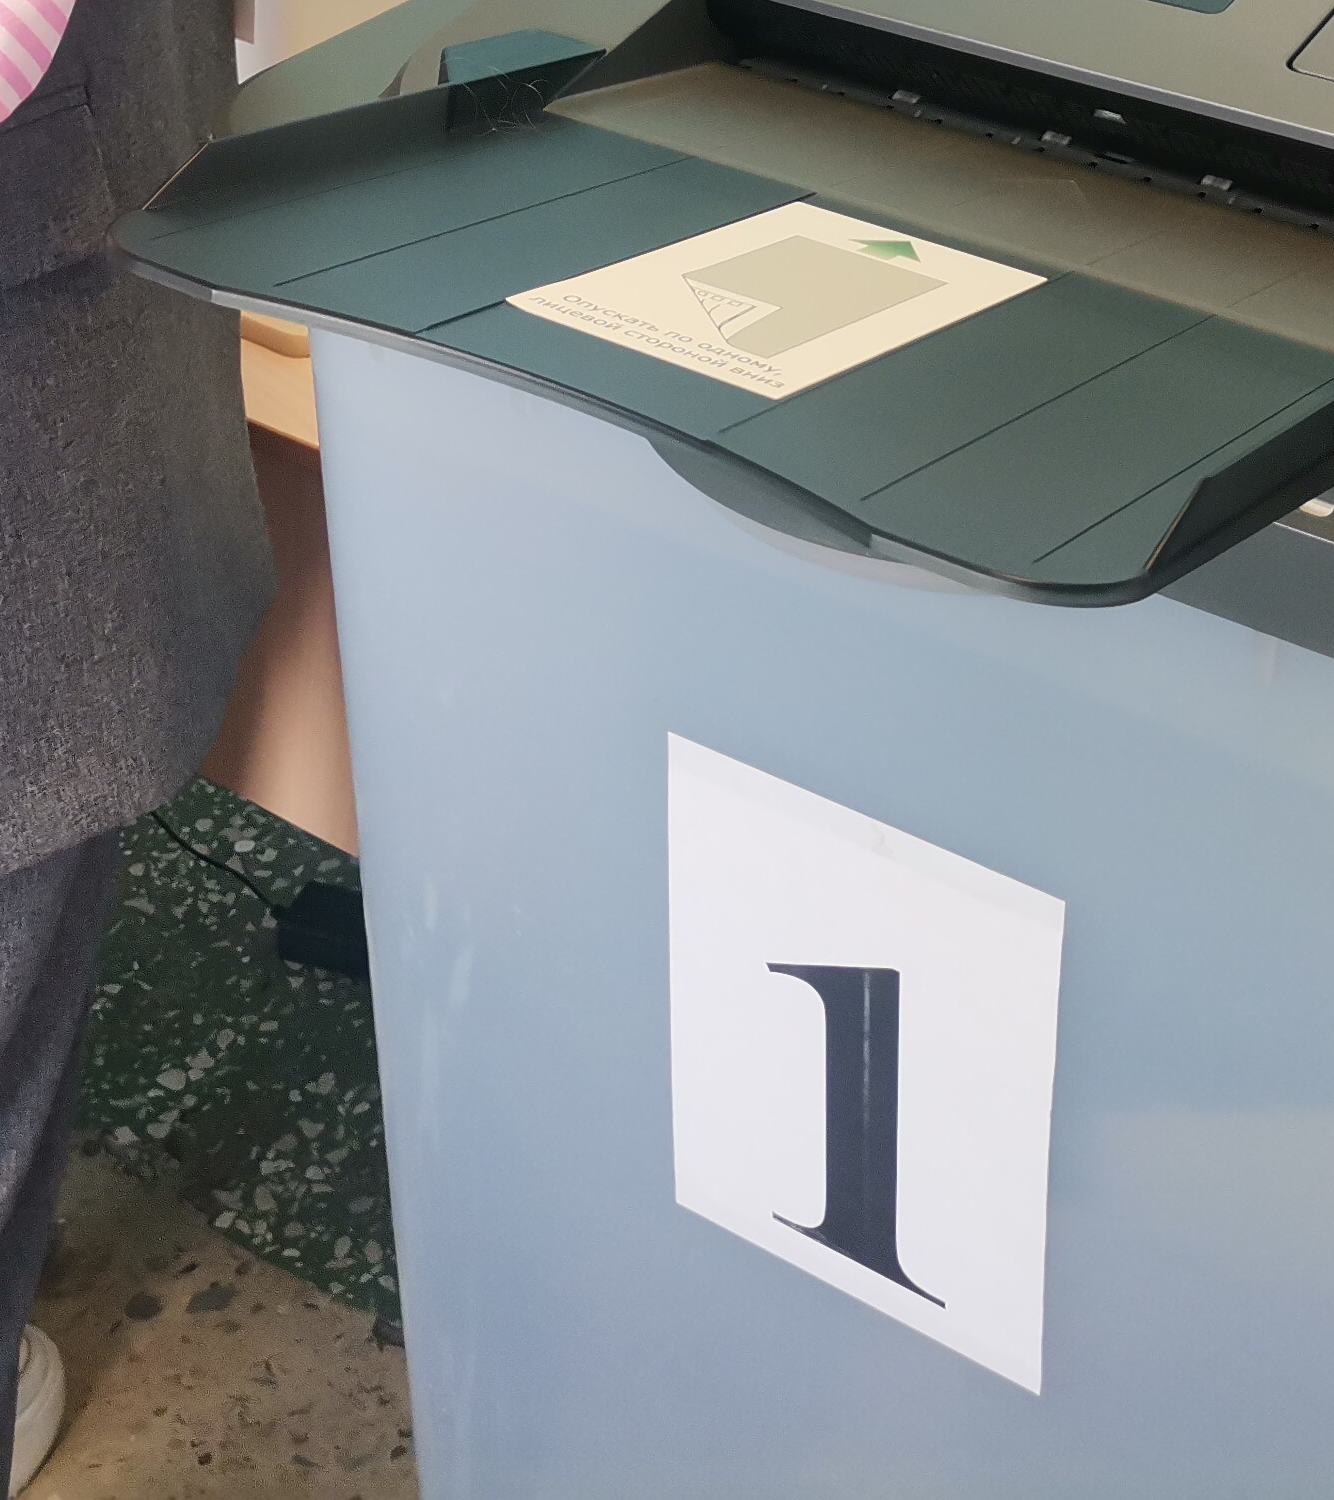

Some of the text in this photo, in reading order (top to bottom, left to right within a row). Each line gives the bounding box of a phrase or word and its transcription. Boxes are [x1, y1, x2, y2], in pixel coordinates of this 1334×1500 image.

[529, 296, 785, 389] лицевой стороной вниз
[563, 295, 782, 376] Опускать по одному,
[765, 961, 946, 1309] 1
